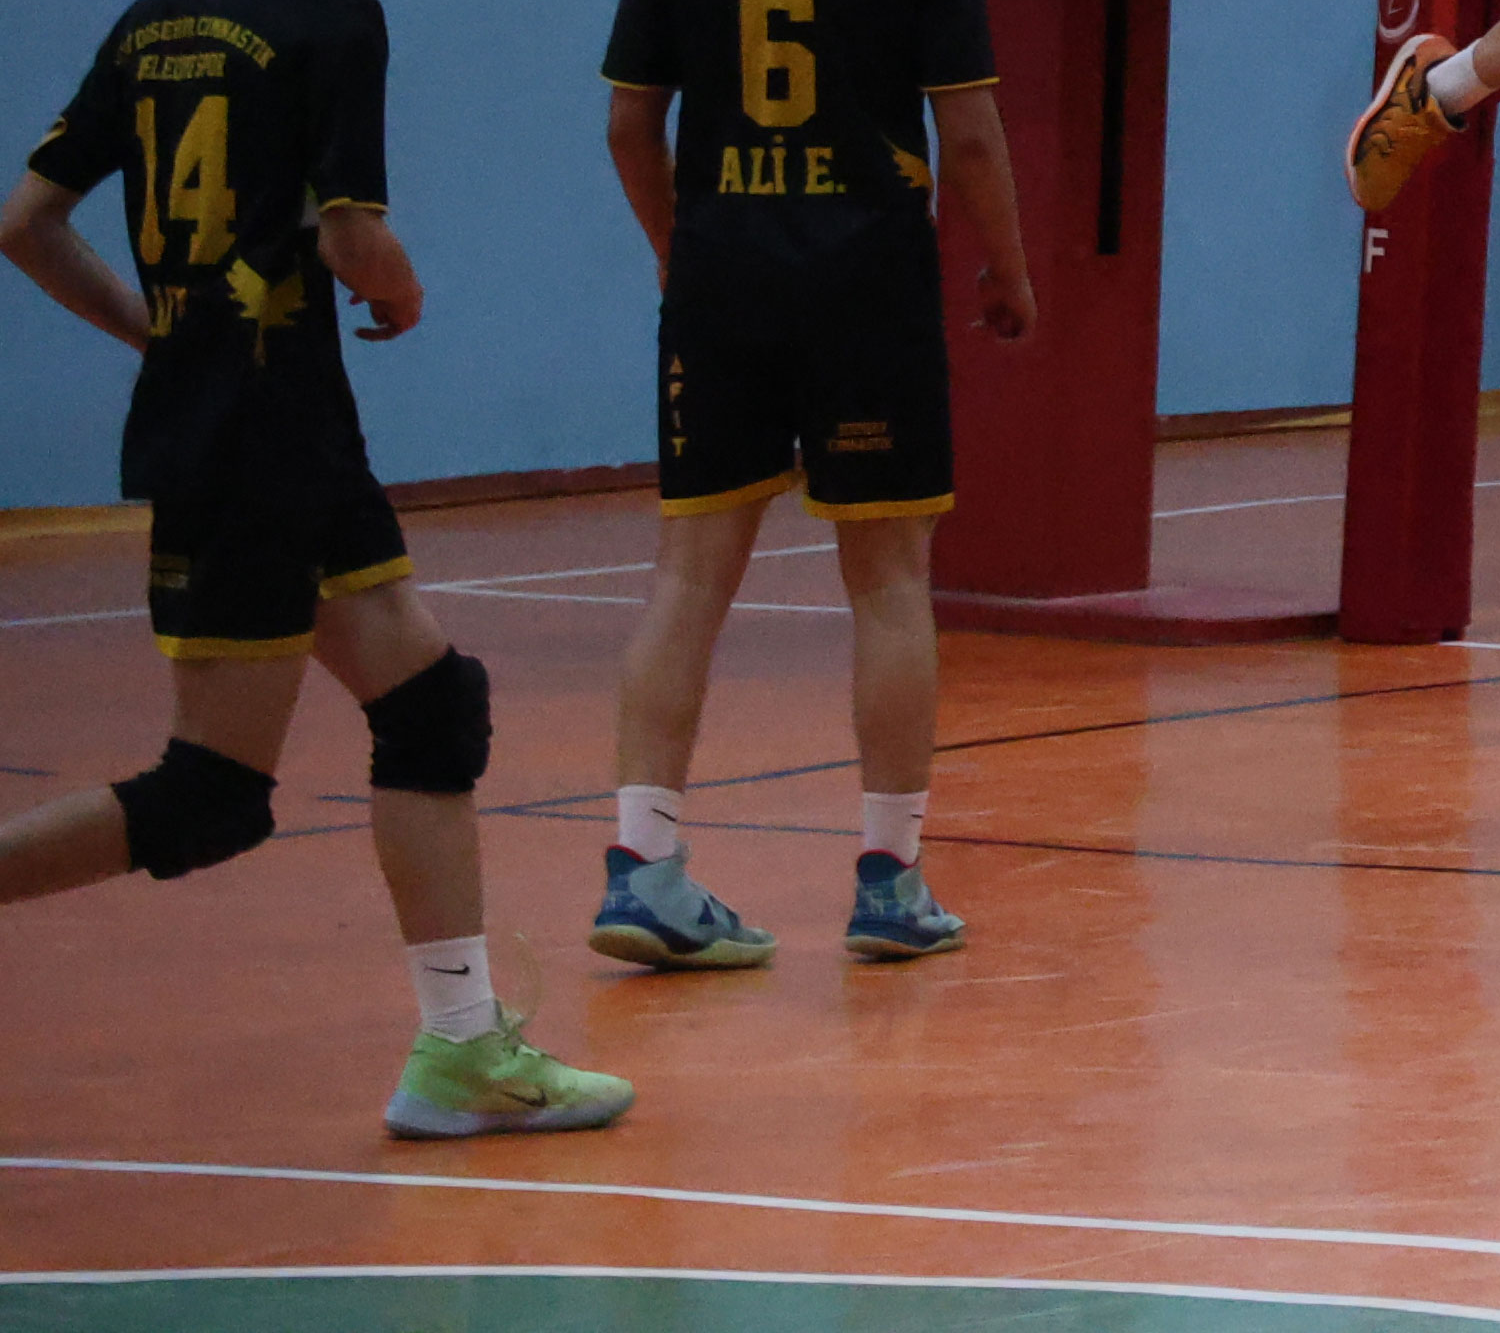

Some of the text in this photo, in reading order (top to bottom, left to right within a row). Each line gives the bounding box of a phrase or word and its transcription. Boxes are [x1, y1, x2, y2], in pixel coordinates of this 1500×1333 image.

[135, 96, 237, 265] 14
[718, 135, 847, 194] ALİ E.
